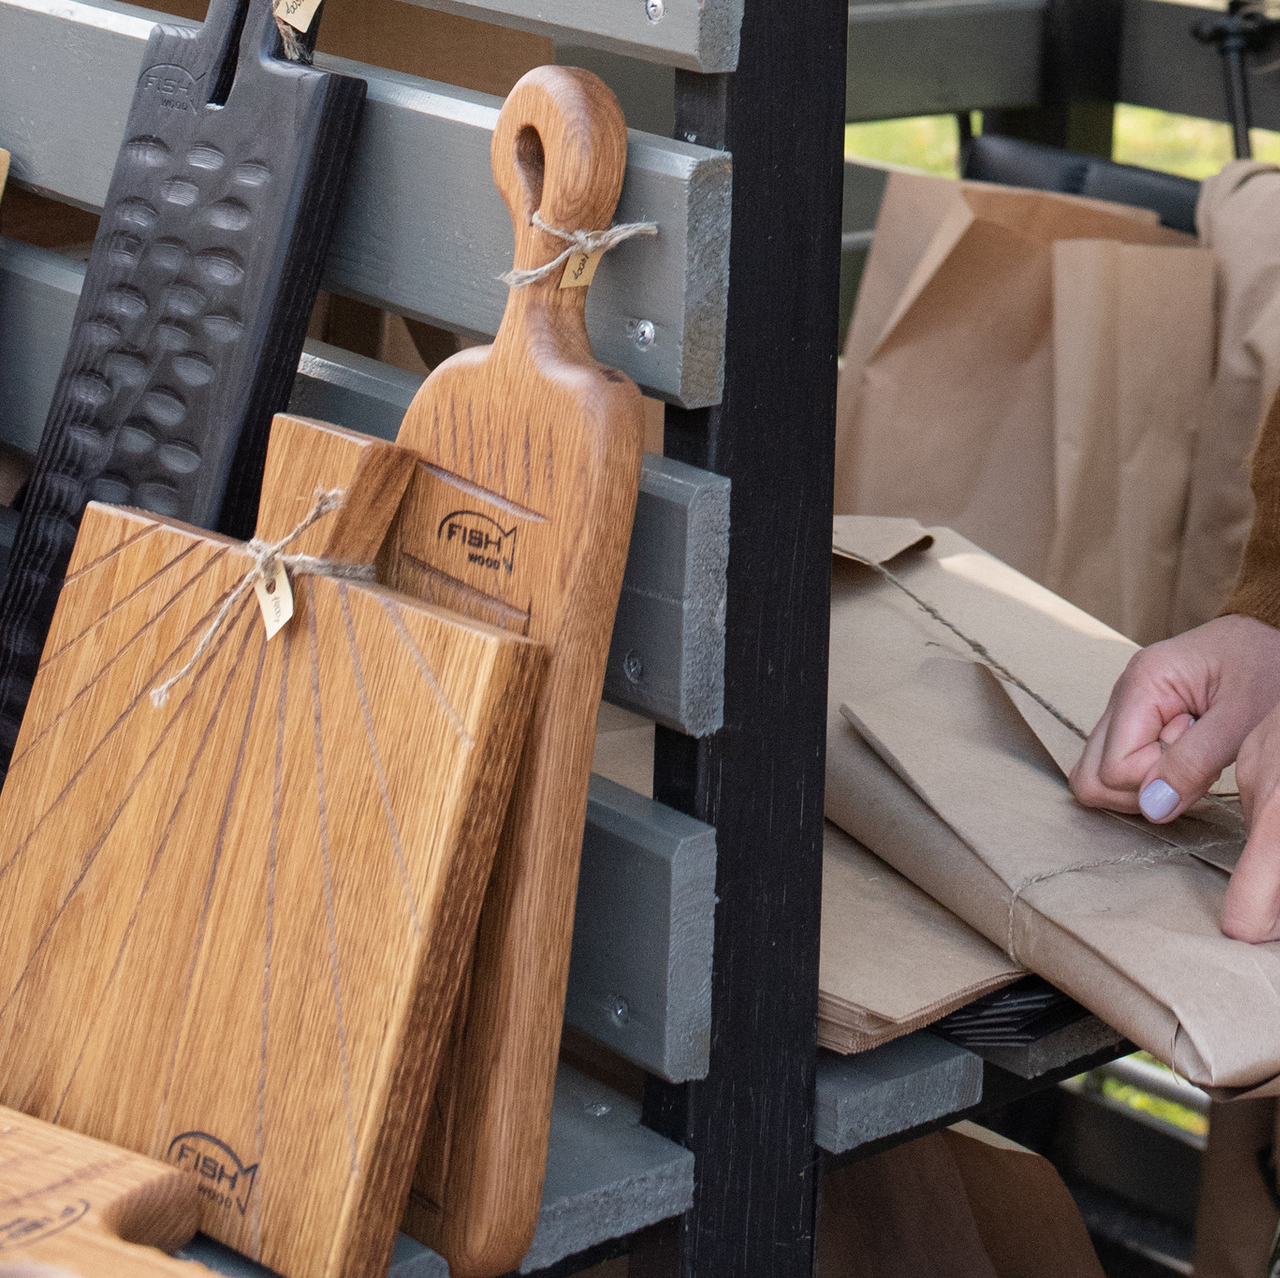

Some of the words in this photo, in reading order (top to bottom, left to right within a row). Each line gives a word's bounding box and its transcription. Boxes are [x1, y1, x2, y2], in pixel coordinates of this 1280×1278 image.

[143, 74, 192, 98] FISH
[447, 522, 503, 554] FISH
[467, 552, 501, 571] WOOD
[176, 1143, 239, 1192] FISH
